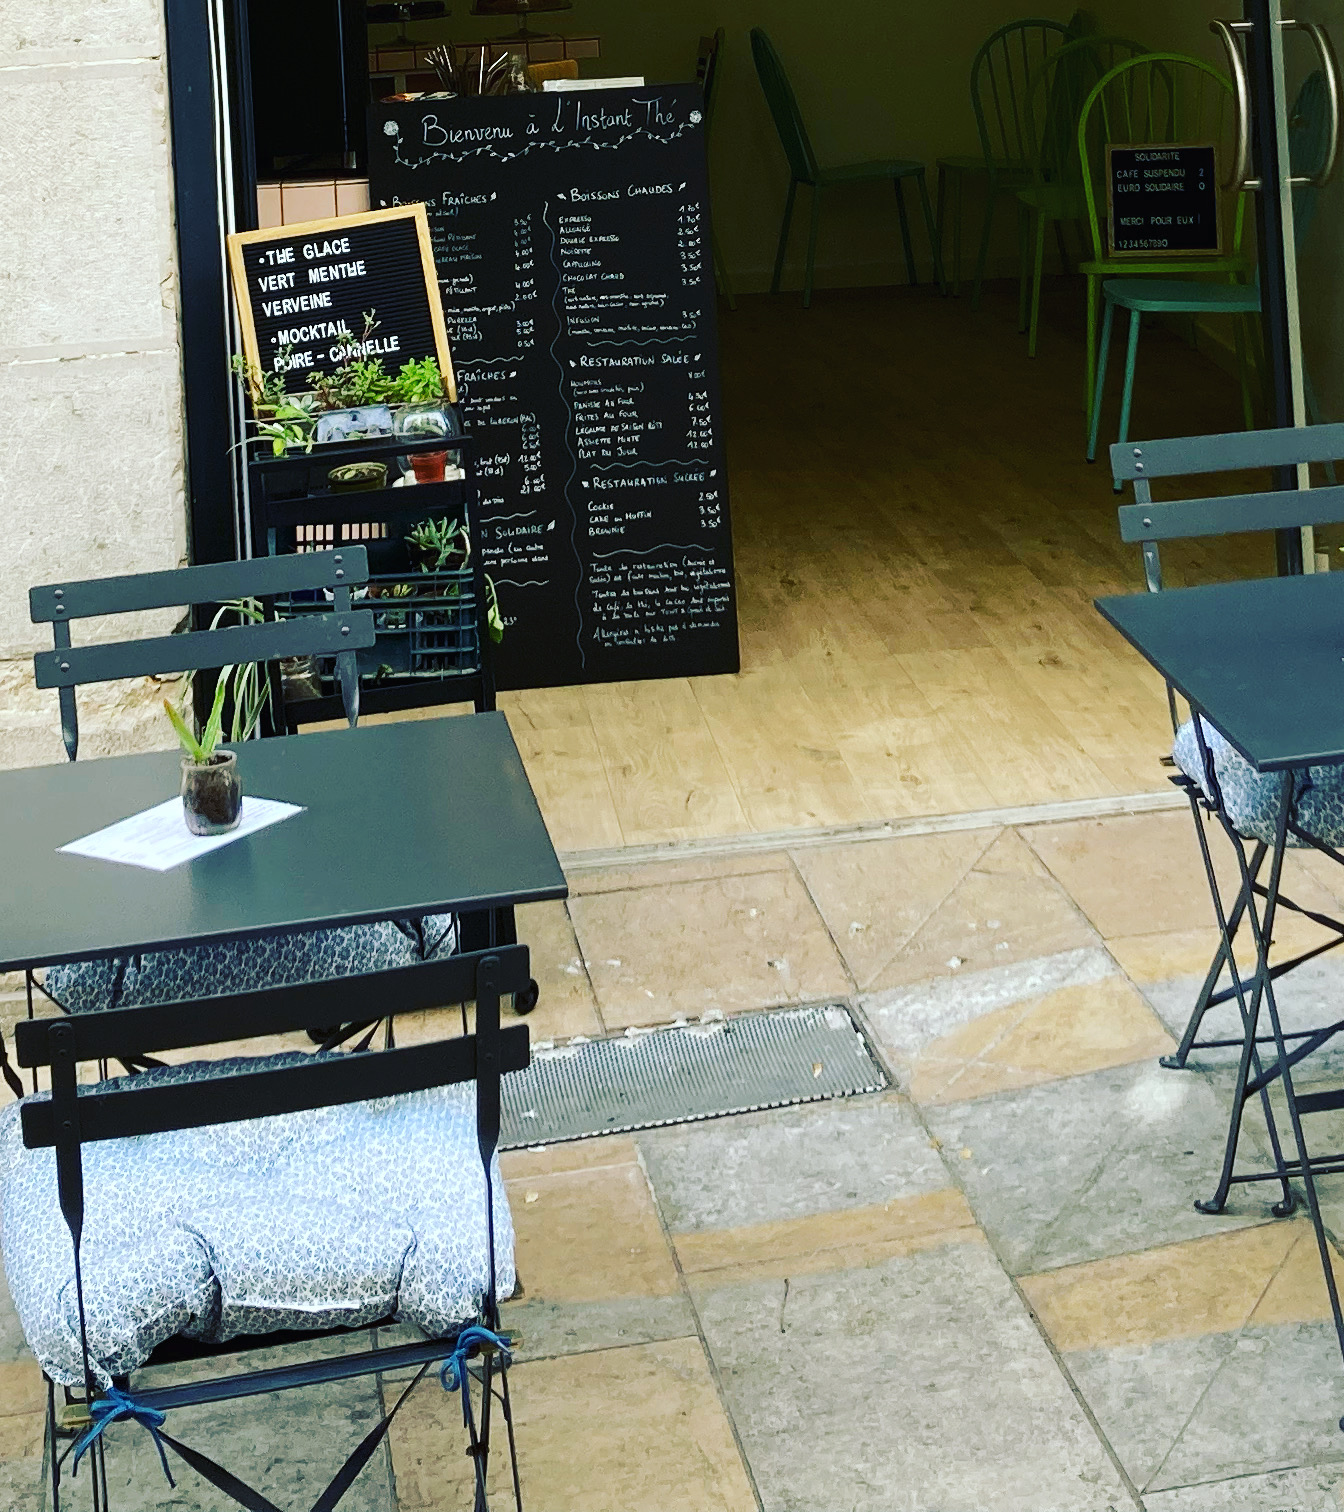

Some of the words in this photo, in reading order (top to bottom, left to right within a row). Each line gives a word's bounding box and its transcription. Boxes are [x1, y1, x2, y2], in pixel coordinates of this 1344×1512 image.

[421, 114, 514, 146] Bienvenu
[526, 114, 540, 135] à
[631, 96, 677, 125] Thé
[1135, 152, 1180, 162] SOLIDARITE
[1117, 169, 1139, 179] CAFE
[1144, 168, 1186, 178] SUSPENDU
[571, 189, 620, 203] BOISSONS
[627, 182, 674, 197] CHAUDES
[1117, 183, 1141, 192] EURO
[1144, 182, 1185, 192] SOLIDAIRE
[1120, 216, 1144, 225] MERCI
[1150, 216, 1172, 225] POUR
[266, 247, 296, 266] THE
[303, 238, 351, 260] GLACE
[258, 272, 296, 293] VERT
[308, 260, 367, 284] MENTHE
[262, 292, 333, 318] VERVEINE
[278, 318, 351, 345] MOCKTAIL
[580, 355, 655, 367] RESTAURATION
